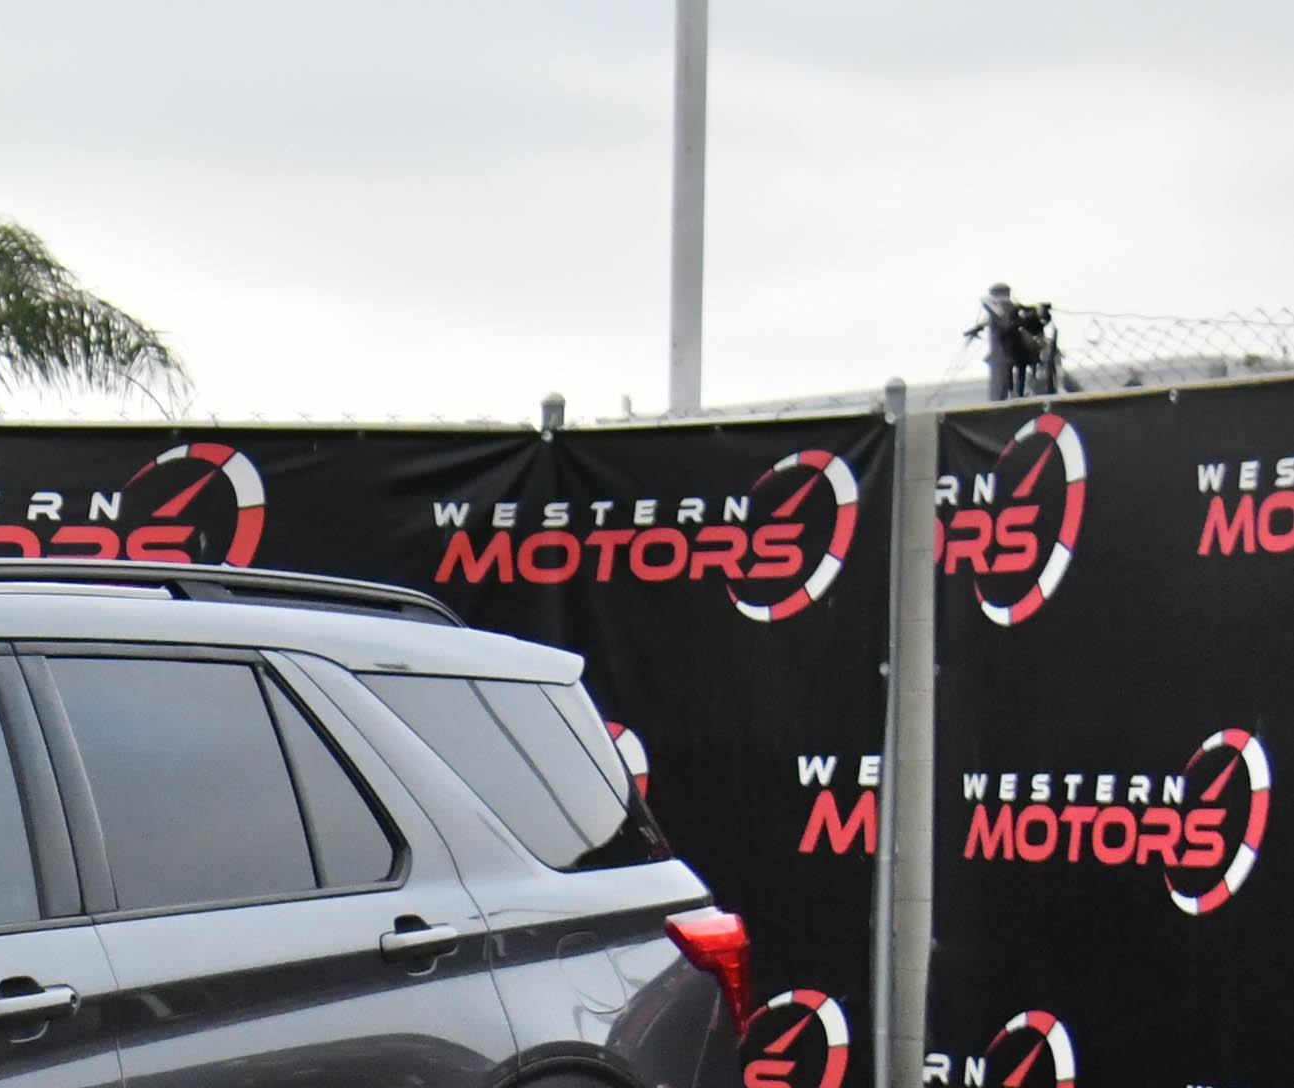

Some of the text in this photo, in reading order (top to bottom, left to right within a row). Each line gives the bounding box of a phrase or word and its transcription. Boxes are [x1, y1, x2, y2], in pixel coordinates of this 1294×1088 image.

[433, 496, 749, 527] WESTERN
[934, 505, 1040, 575] RS
[434, 523, 805, 584] MOTORS
[963, 773, 1185, 804] WESTERN
[963, 804, 1228, 868] MOTORS
